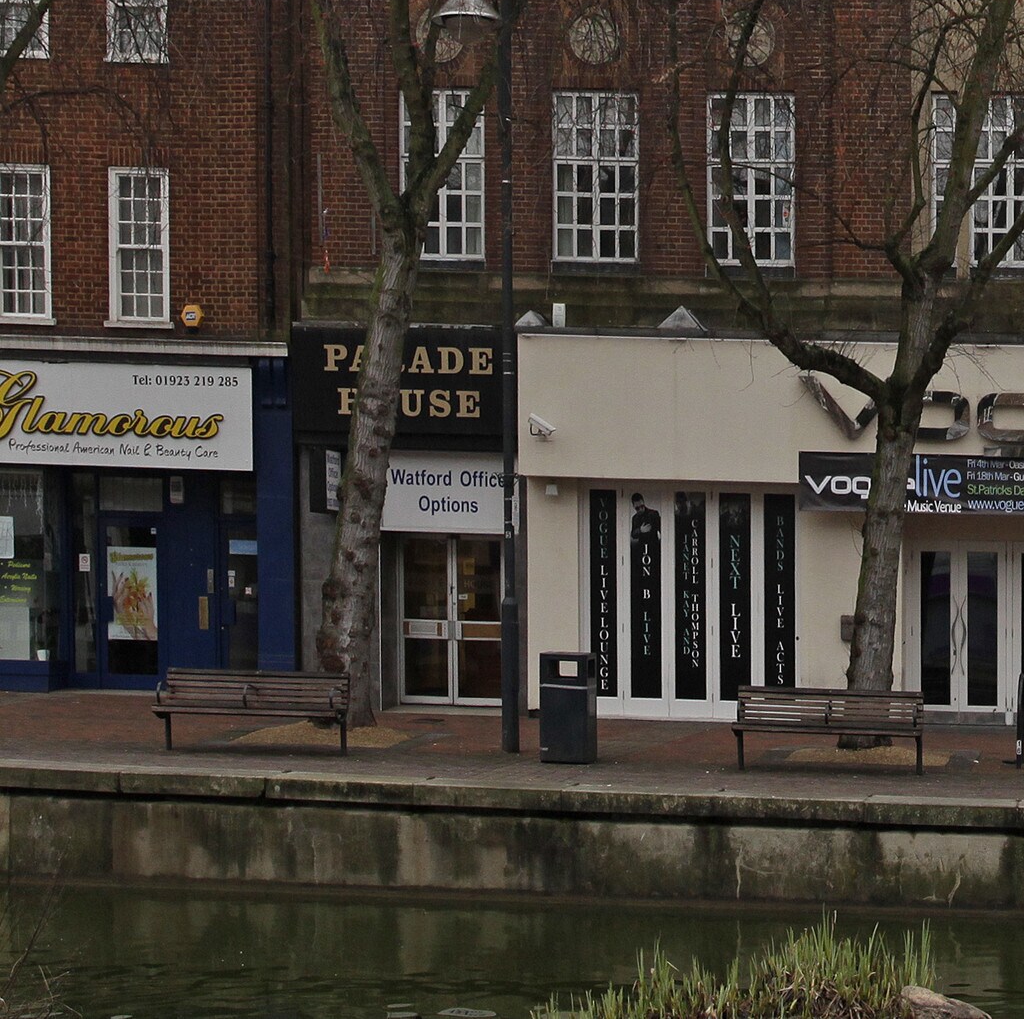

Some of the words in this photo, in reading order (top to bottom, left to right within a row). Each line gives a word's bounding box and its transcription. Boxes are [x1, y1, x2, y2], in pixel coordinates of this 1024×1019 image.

[323, 344, 493, 375] PAADE
[132, 375, 152, 386] Tel:
[155, 375, 190, 387] 01923
[194, 376, 214, 387] 219
[218, 377, 239, 387] 285
[0, 369, 224, 439] Glamorous
[337, 388, 481, 418] HUSE
[8, 438, 70, 455] Professional
[73, 441, 115, 455] American
[119, 443, 140, 456] Nail
[156, 444, 191, 460] Beauty
[194, 446, 219, 459] Care
[391, 469, 452, 487] Watford
[967, 471, 975, 481] Fri
[976, 472, 994, 481] 18th
[994, 472, 1009, 481] Mar
[418, 495, 479, 515] Options
[907, 499, 934, 512] Music
[935, 500, 961, 513] Venue
[691, 519, 699, 584] CARROLL
[776, 516, 785, 572] BANDS
[641, 544, 651, 576] JON
[730, 535, 741, 590] NEXT
[643, 589, 651, 599] B
[643, 611, 651, 655] LIVE
[691, 594, 699, 667] THOMPSON
[731, 603, 741, 658] LIVE
[776, 641, 785, 685] ACTS
